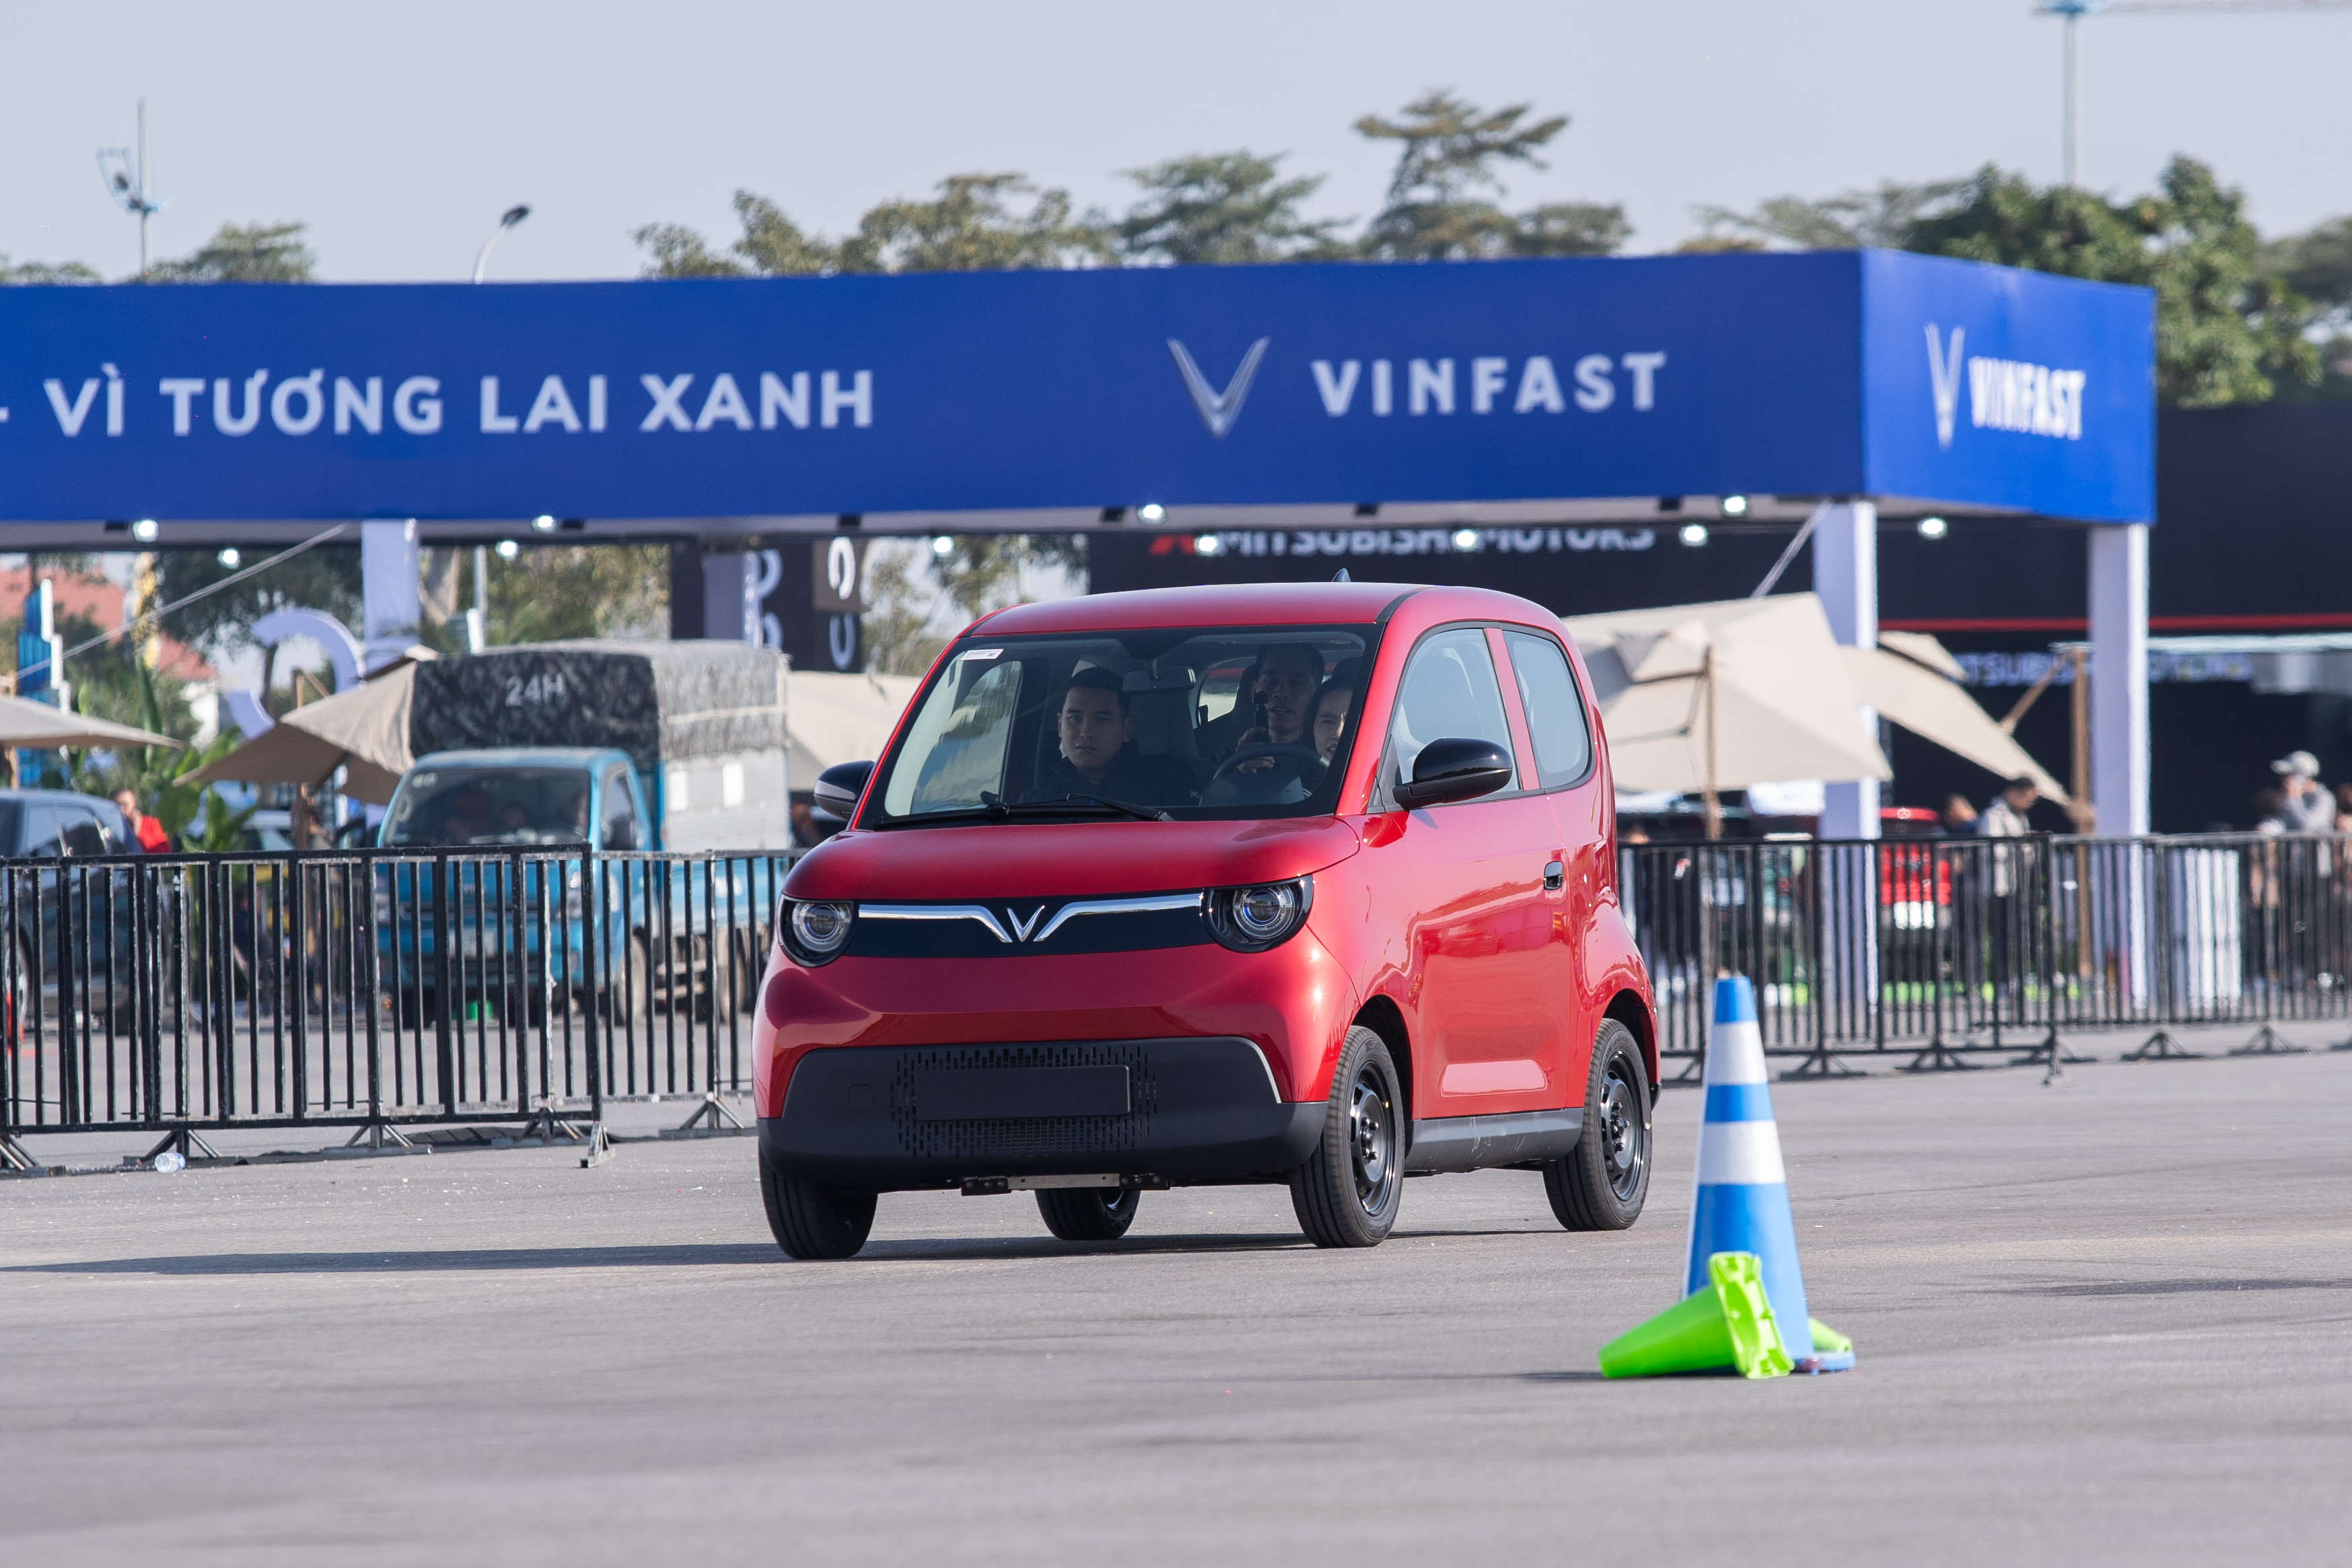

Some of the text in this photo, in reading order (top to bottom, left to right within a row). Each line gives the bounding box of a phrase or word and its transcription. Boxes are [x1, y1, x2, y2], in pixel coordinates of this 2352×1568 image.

[43, 362, 874, 437] VÌ TƯƠNG LAI XANH
[1310, 351, 1667, 417] VINFAST
[1968, 355, 2086, 441] VINFAST
[505, 672, 565, 707] 24H
